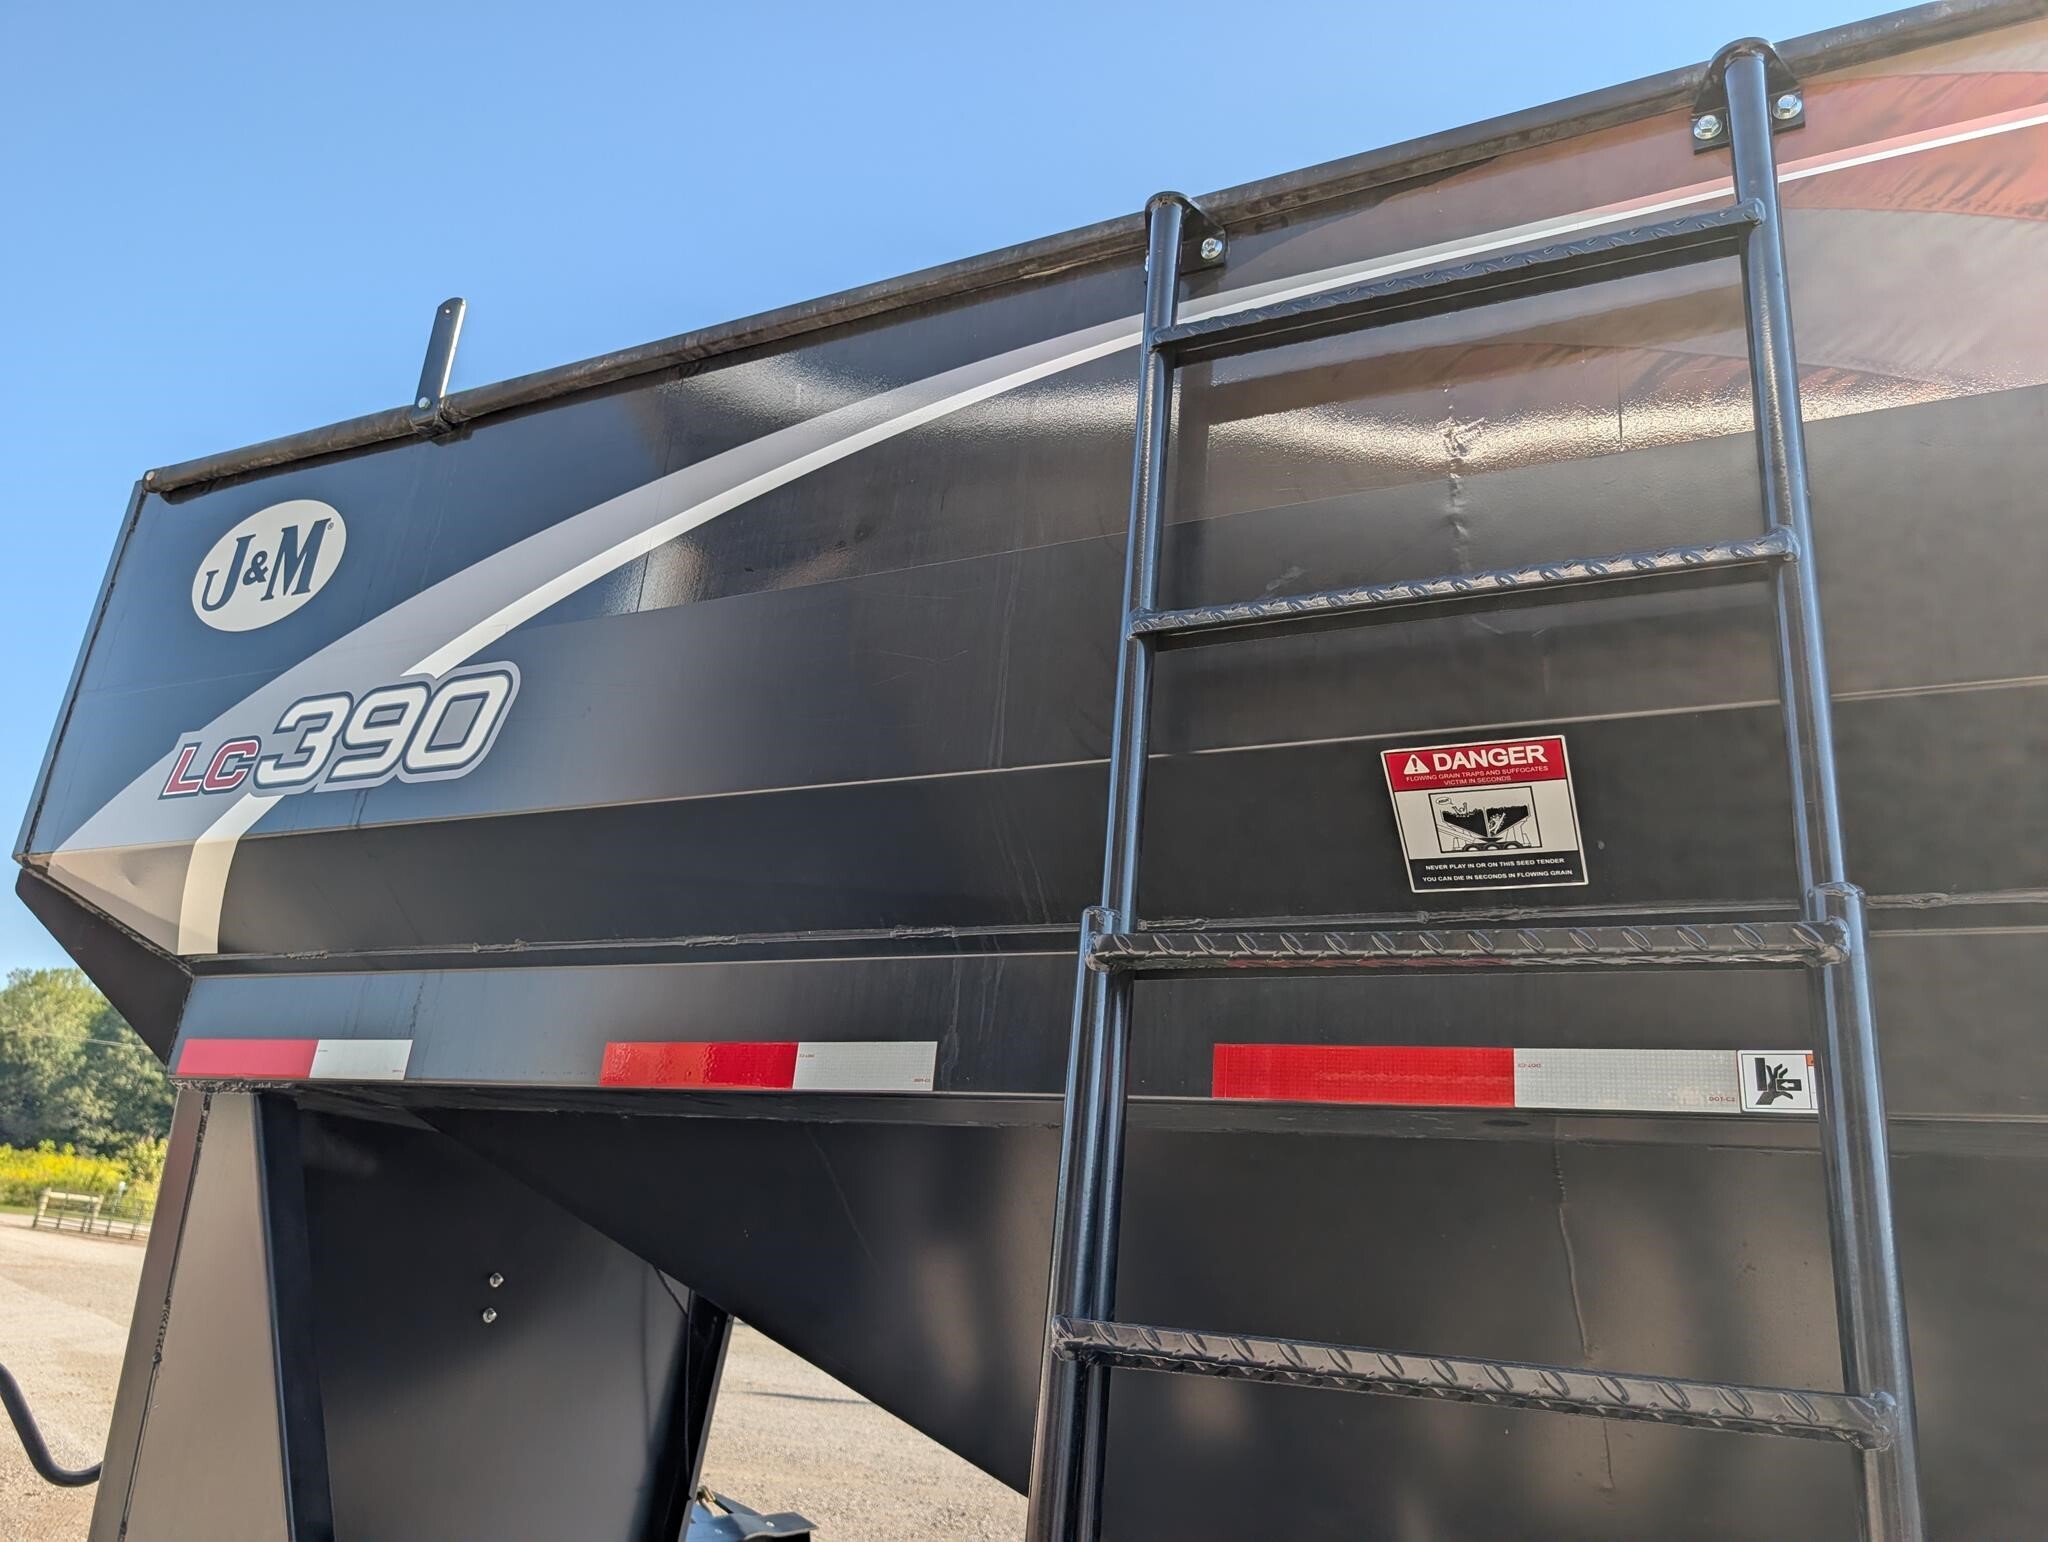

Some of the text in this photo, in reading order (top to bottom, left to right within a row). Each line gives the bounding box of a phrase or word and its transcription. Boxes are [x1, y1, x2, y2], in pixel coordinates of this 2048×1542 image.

[201, 516, 332, 612] J&M
[1433, 745, 1548, 771] DANGER
[1406, 774, 1437, 782] FLOWING
[1438, 772, 1461, 780] GRAIN
[1462, 770, 1485, 778] TRAPS
[1501, 765, 1549, 775] SUFFOCATES
[1443, 778, 1468, 786] VICTIM
[1477, 775, 1512, 783] SECONDS
[1536, 857, 1565, 865] TENDER
[1516, 870, 1549, 878] FLOWING
[1550, 868, 1573, 876] GRAIN
